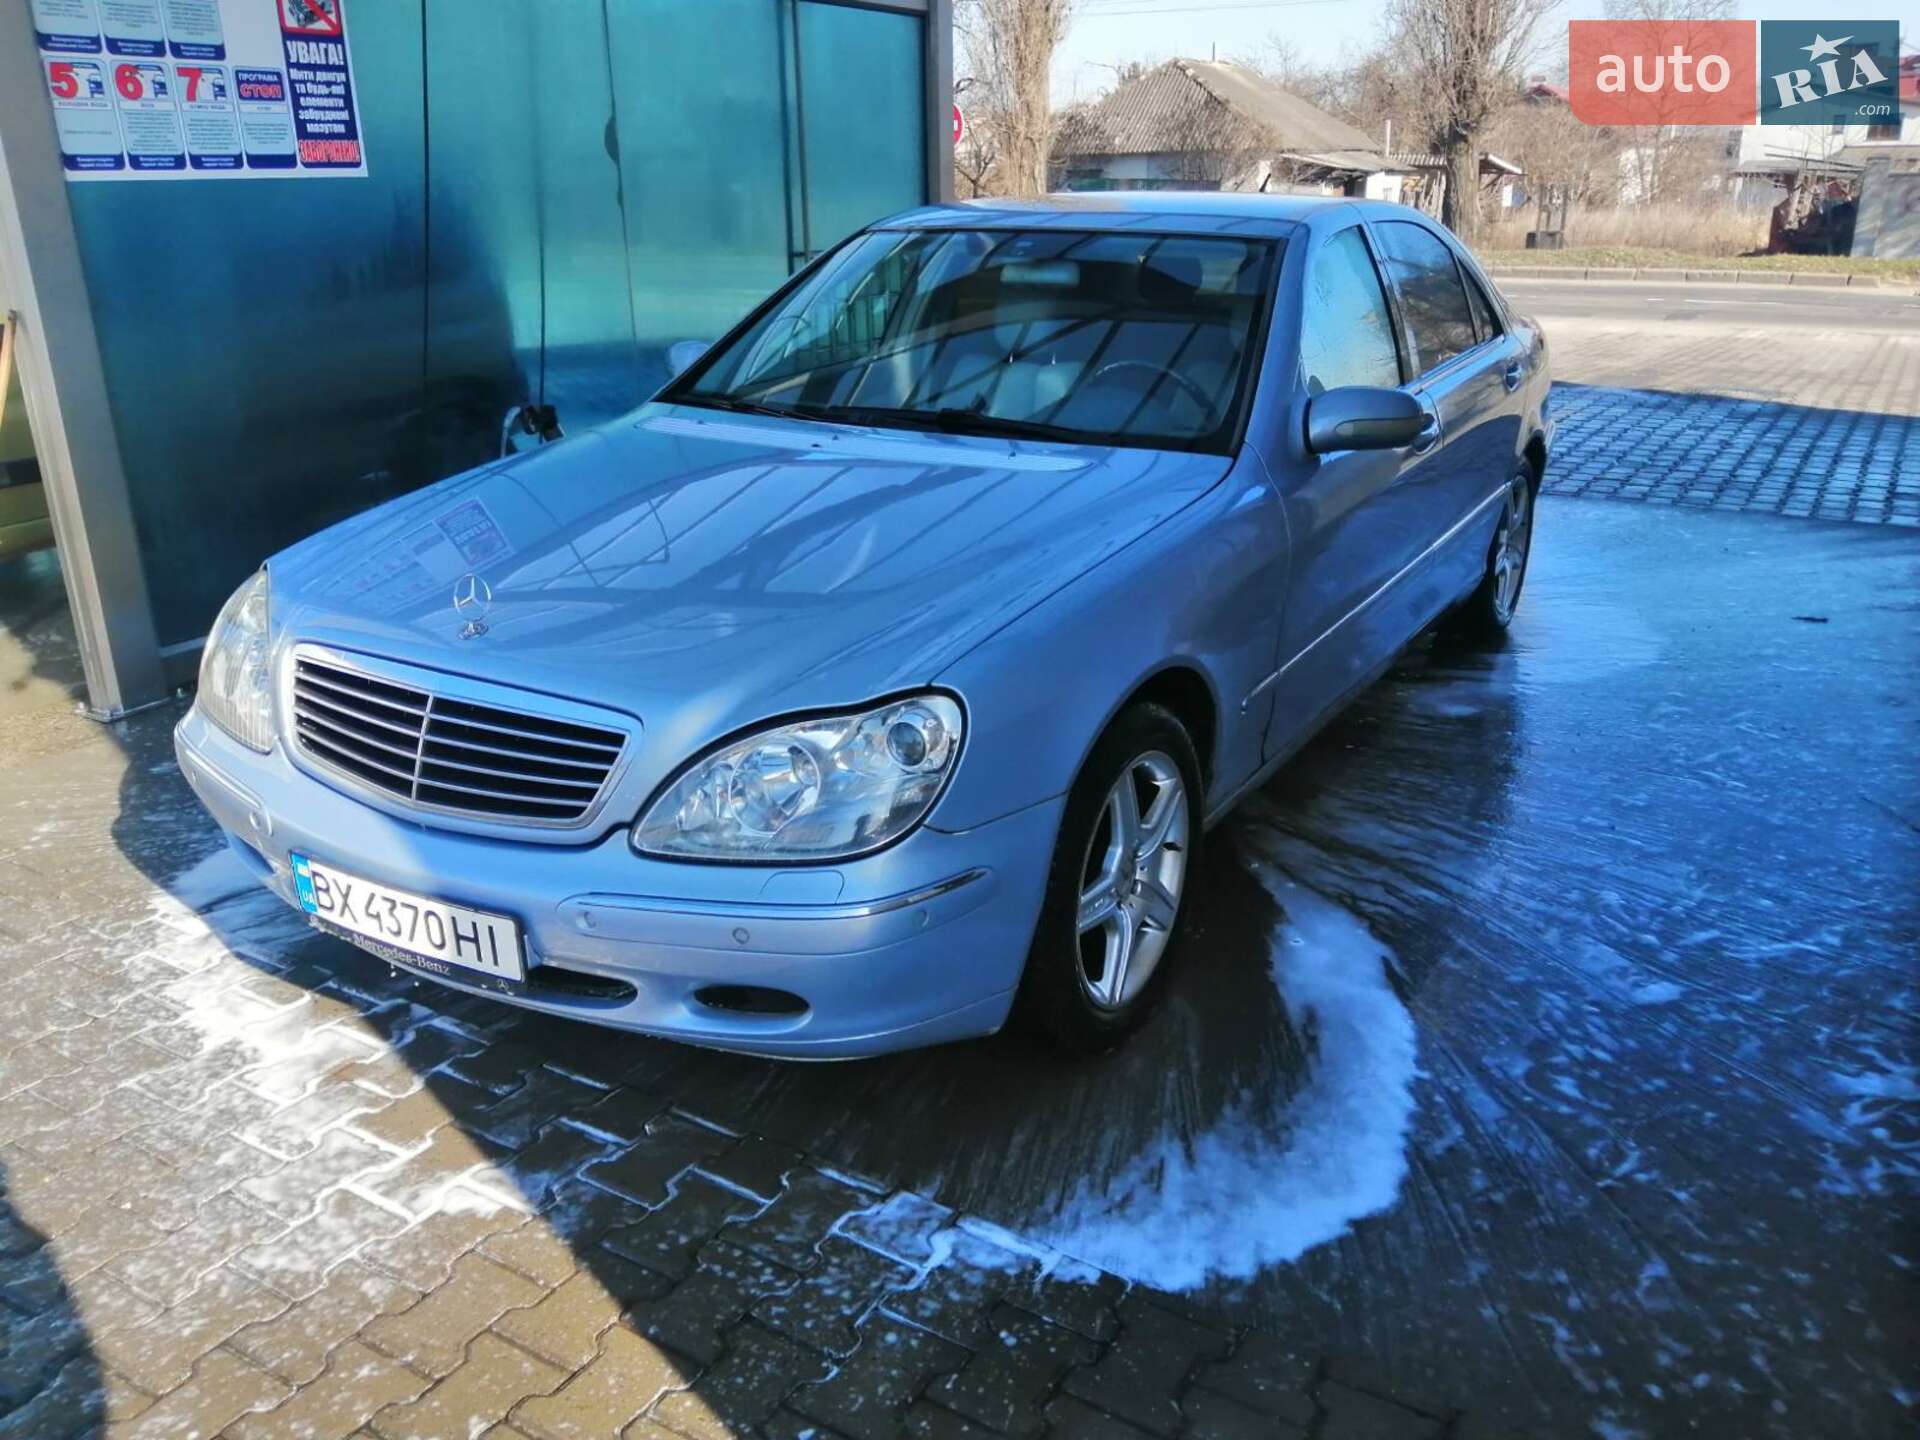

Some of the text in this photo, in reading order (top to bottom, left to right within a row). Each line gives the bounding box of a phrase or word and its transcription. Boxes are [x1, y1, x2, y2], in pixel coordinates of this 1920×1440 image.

[286, 40, 344, 66] УВАГА!
[49, 62, 78, 99] 5
[115, 63, 143, 100] 6
[176, 67, 202, 102] 7
[238, 73, 279, 82] ПРОГРАМА
[240, 83, 282, 99] СТОП
[302, 888, 315, 906] UA
[365, 892, 446, 951] 4370
